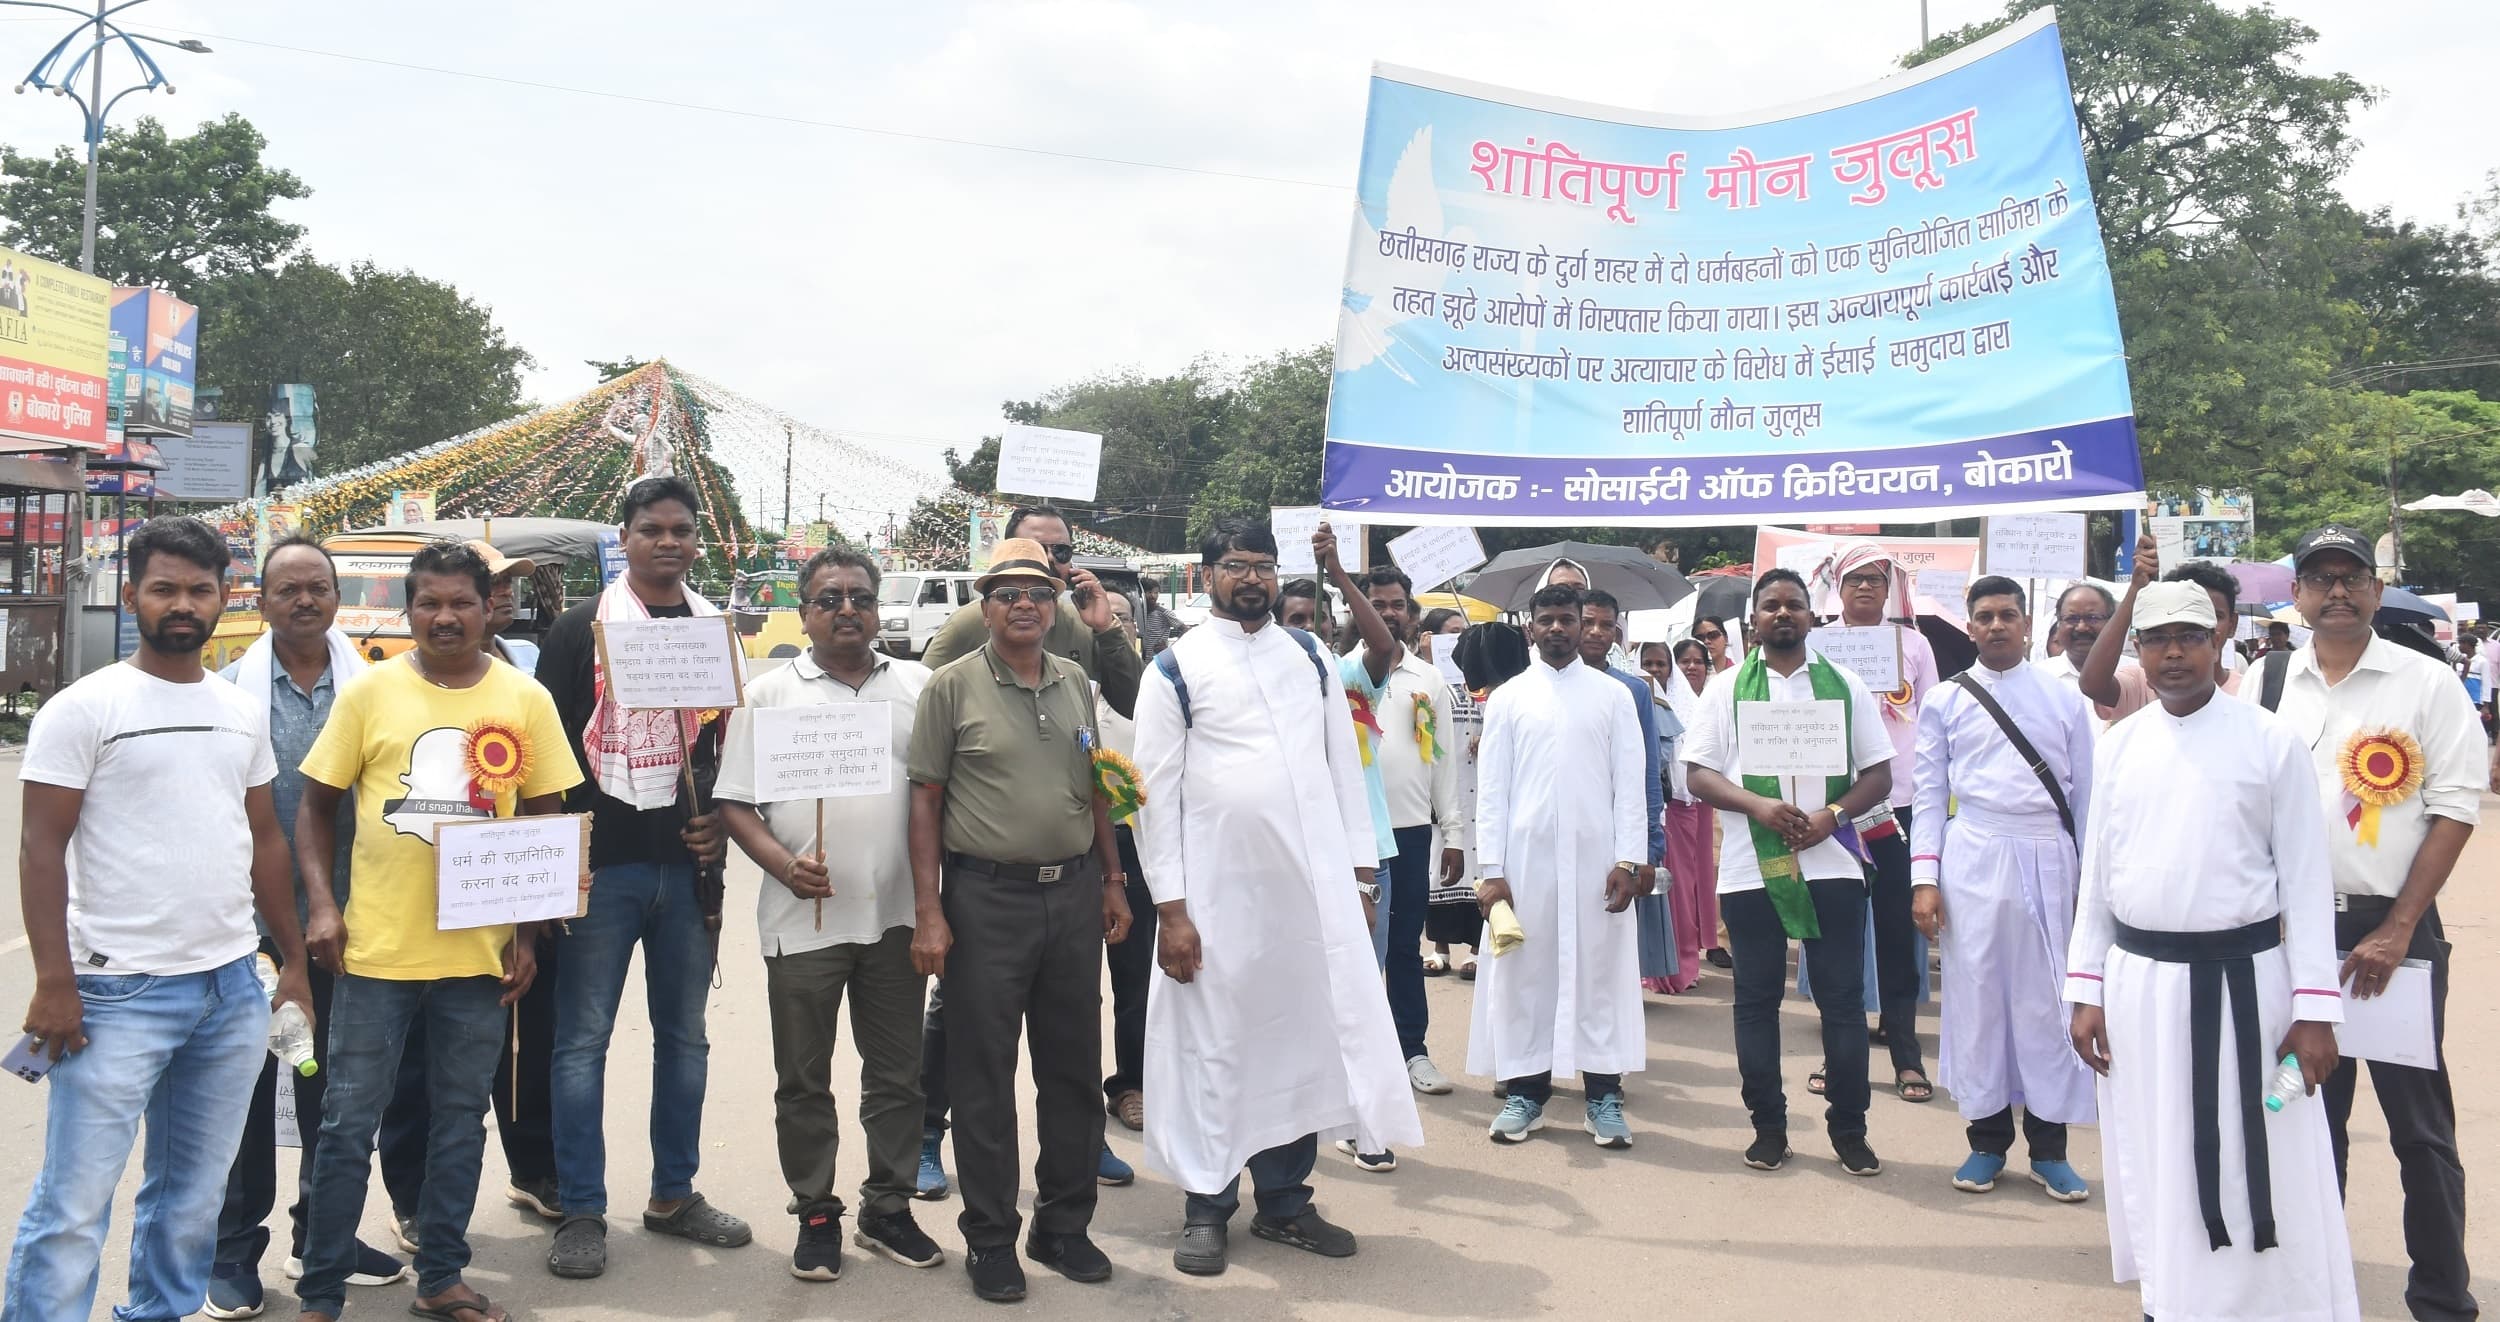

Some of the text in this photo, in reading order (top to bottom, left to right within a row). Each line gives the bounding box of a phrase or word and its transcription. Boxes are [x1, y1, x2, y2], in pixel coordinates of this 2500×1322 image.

[1471, 107, 1977, 224] शांतिपूर्ण मौन जुलूस
[1379, 180, 2069, 288] छत्तीसगढ़ राज्य के दुर्ग शहर में दो धर्मबहनों को एक सुनियोजित साजिश के
[1393, 243, 2060, 333] तहत झूठे आरोपों में गिरफ्तार किया गया। इस अन्यायपूर्ण कार्रवाई और
[1443, 320, 2010, 384] अल्पसंख्यकों पर अत्याचार के विरोध में ईसाई समुदाय द्वारा
[27, 394, 60, 422] बोकारो
[63, 402, 92, 430] पुलिस
[1623, 397, 1822, 441] शांतिपूर्ण मौन जुलूस
[1384, 463, 1521, 501] आयोजक
[1564, 466, 1691, 505] सोसाईटी
[1699, 467, 1773, 501] ऑफ
[1782, 461, 1953, 501] क्रिश्चियन,
[1963, 440, 2073, 487] बोकारो
[1903, 552, 1936, 566] जुलूस
[792, 732, 817, 744] ईसाई
[843, 731, 863, 741] अन्य
[873, 746, 885, 757] पर
[778, 768, 818, 780] अत्याचार
[824, 767, 833, 776] के
[840, 765, 865, 775] विरोध
[428, 803, 453, 814] snap
[452, 848, 472, 868] धर्म
[480, 850, 497, 866] की
[461, 877, 495, 891] करना
[502, 873, 520, 886] बंद
